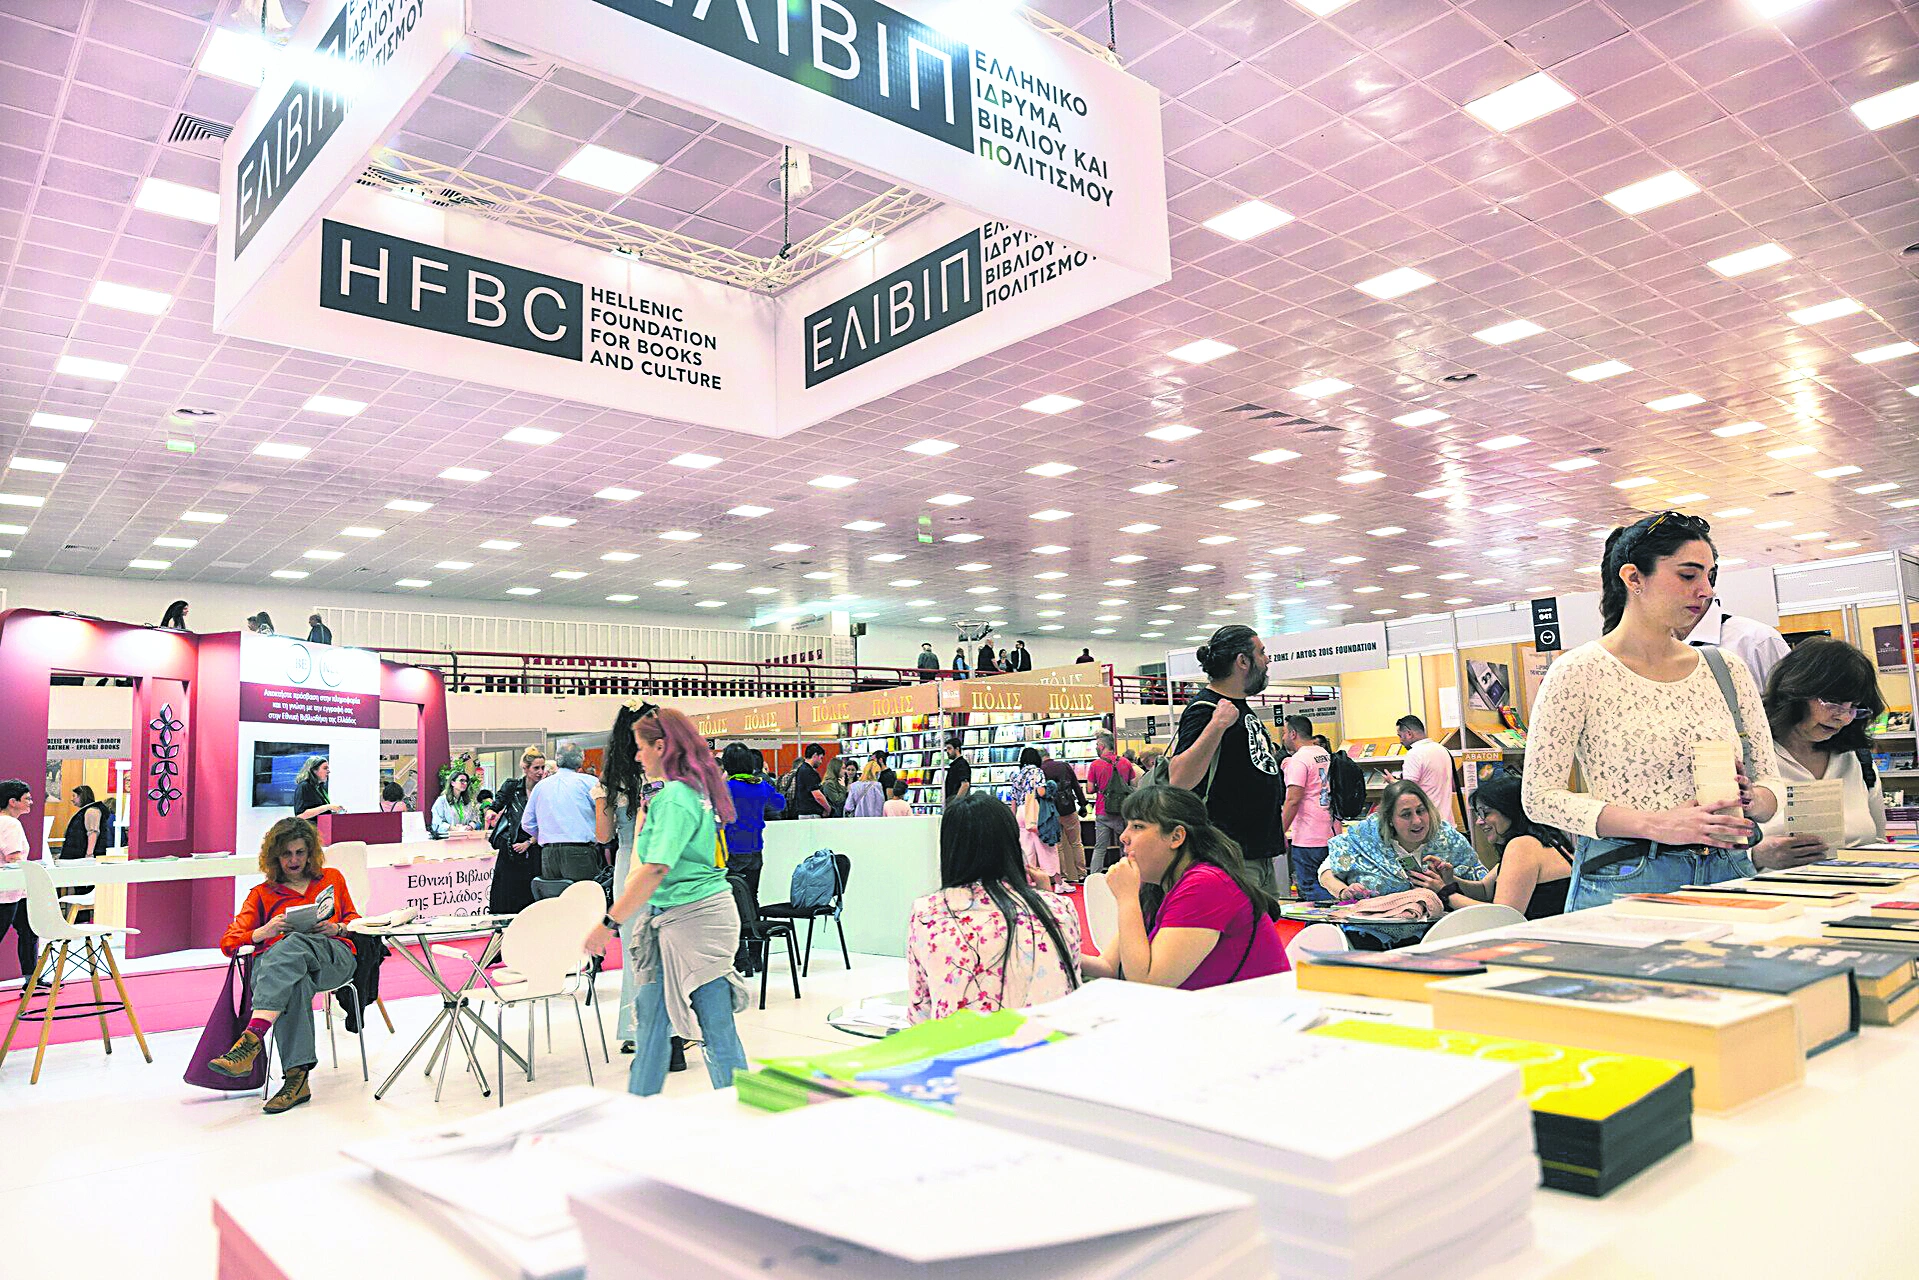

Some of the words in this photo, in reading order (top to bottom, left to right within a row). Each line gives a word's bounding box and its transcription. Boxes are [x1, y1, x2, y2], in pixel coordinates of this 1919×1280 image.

[975, 49, 1088, 116] ΕΛΛΗΝΙΚΟ
[977, 78, 1061, 133] ΙΔΡΥΜΑ
[978, 107, 1066, 161] ΒΙΒΛΙΟΥ
[1074, 149, 1108, 179] ΚΑΙ
[979, 136, 1114, 207] ΠΟΛΙΤΙΣΜΟΥ
[984, 230, 1037, 262] ΙΔΡΥ
[985, 241, 1054, 285] ΒΙΒΛΙΟΥ
[340, 238, 569, 342] HFBC
[986, 251, 1096, 308] ΠΟΛΙΤΙΣΜΟ
[591, 286, 683, 322] HELLENIC
[811, 248, 971, 372] ΕΛΙΒΙΠ
[591, 307, 716, 350] FOUNDATION
[591, 328, 630, 350] FOR
[638, 339, 702, 366] BOOKS
[590, 350, 634, 370] AND
[641, 361, 721, 390] CULTURE
[1296, 649, 1317, 660] ARTOS
[1319, 647, 1333, 657] ZOIS
[1335, 641, 1377, 654] FOUNDATION
[407, 896, 429, 910] της
[432, 888, 483, 906] Ελλάδος
[408, 872, 452, 888] Εθνική
